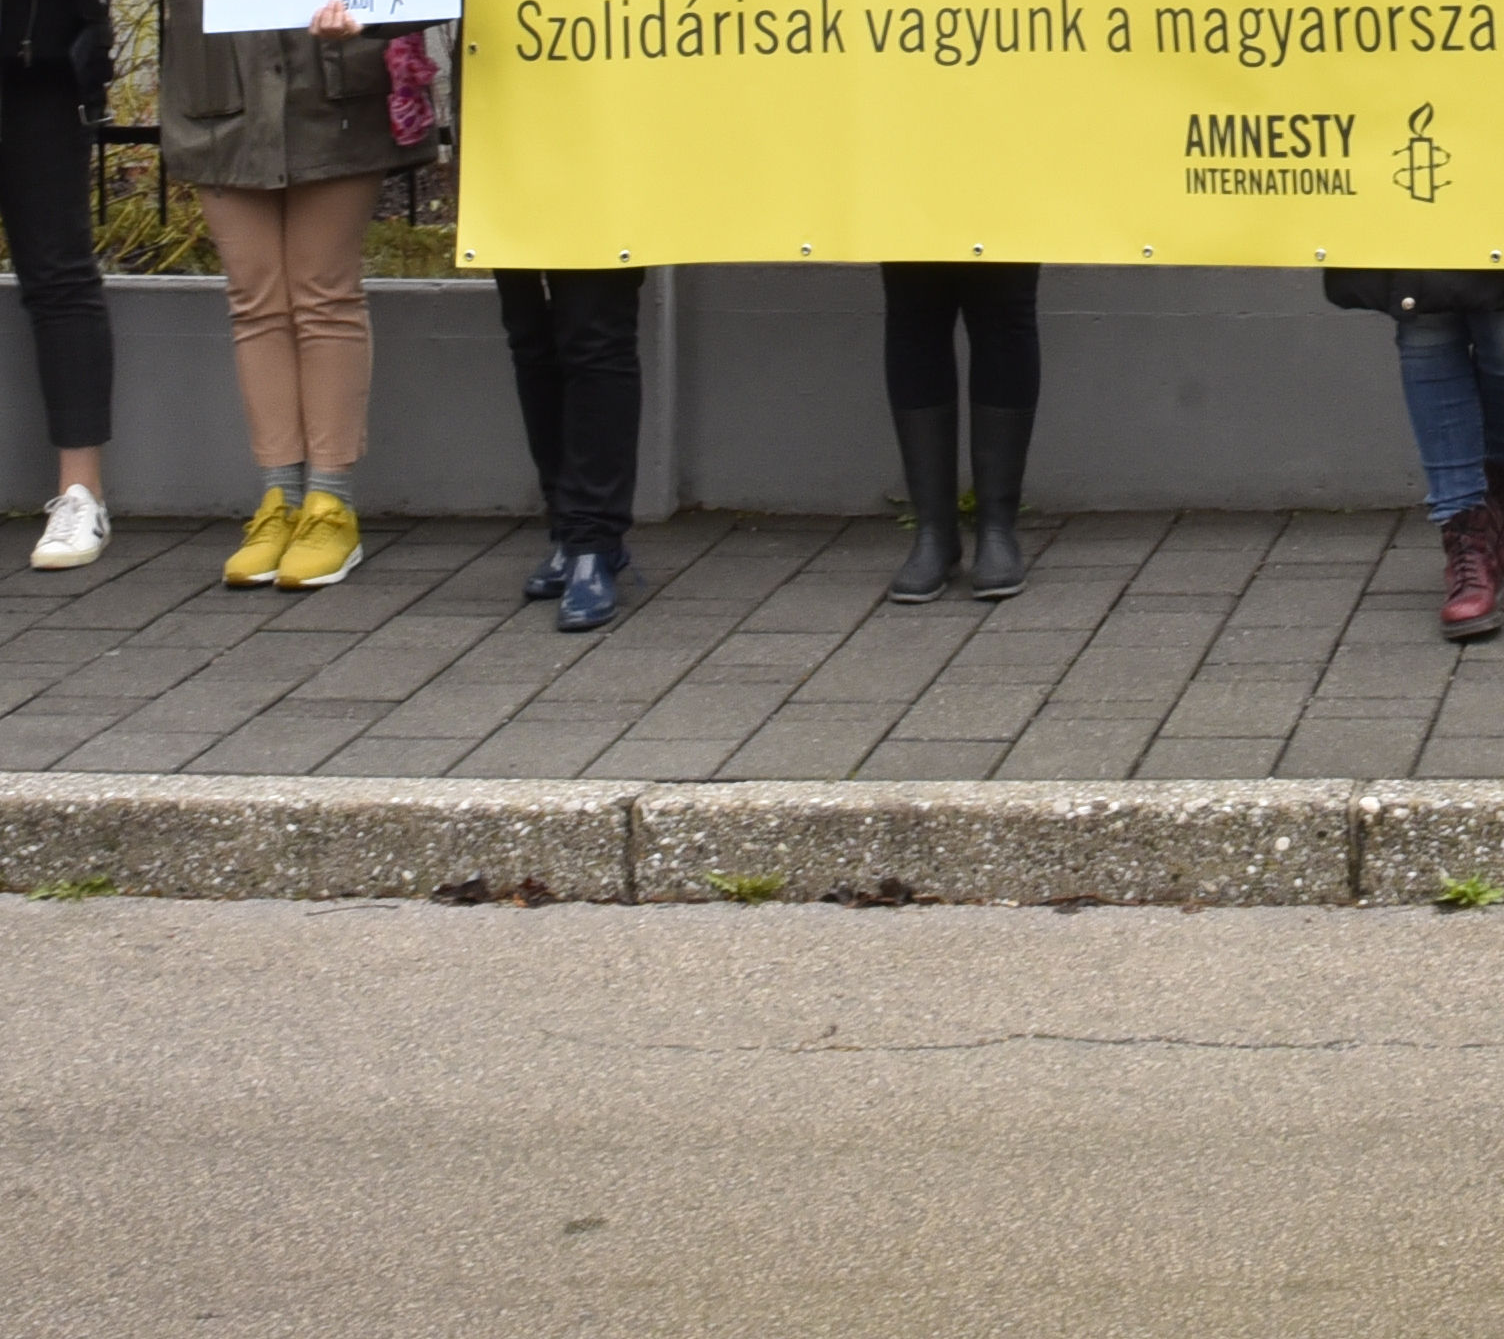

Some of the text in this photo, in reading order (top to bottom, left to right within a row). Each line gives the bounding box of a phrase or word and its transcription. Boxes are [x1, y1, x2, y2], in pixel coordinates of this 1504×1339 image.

[1108, 7, 1132, 54] a
[1185, 113, 1356, 158] AMNESTY
[1185, 168, 1358, 197] INTERNATIONAL
